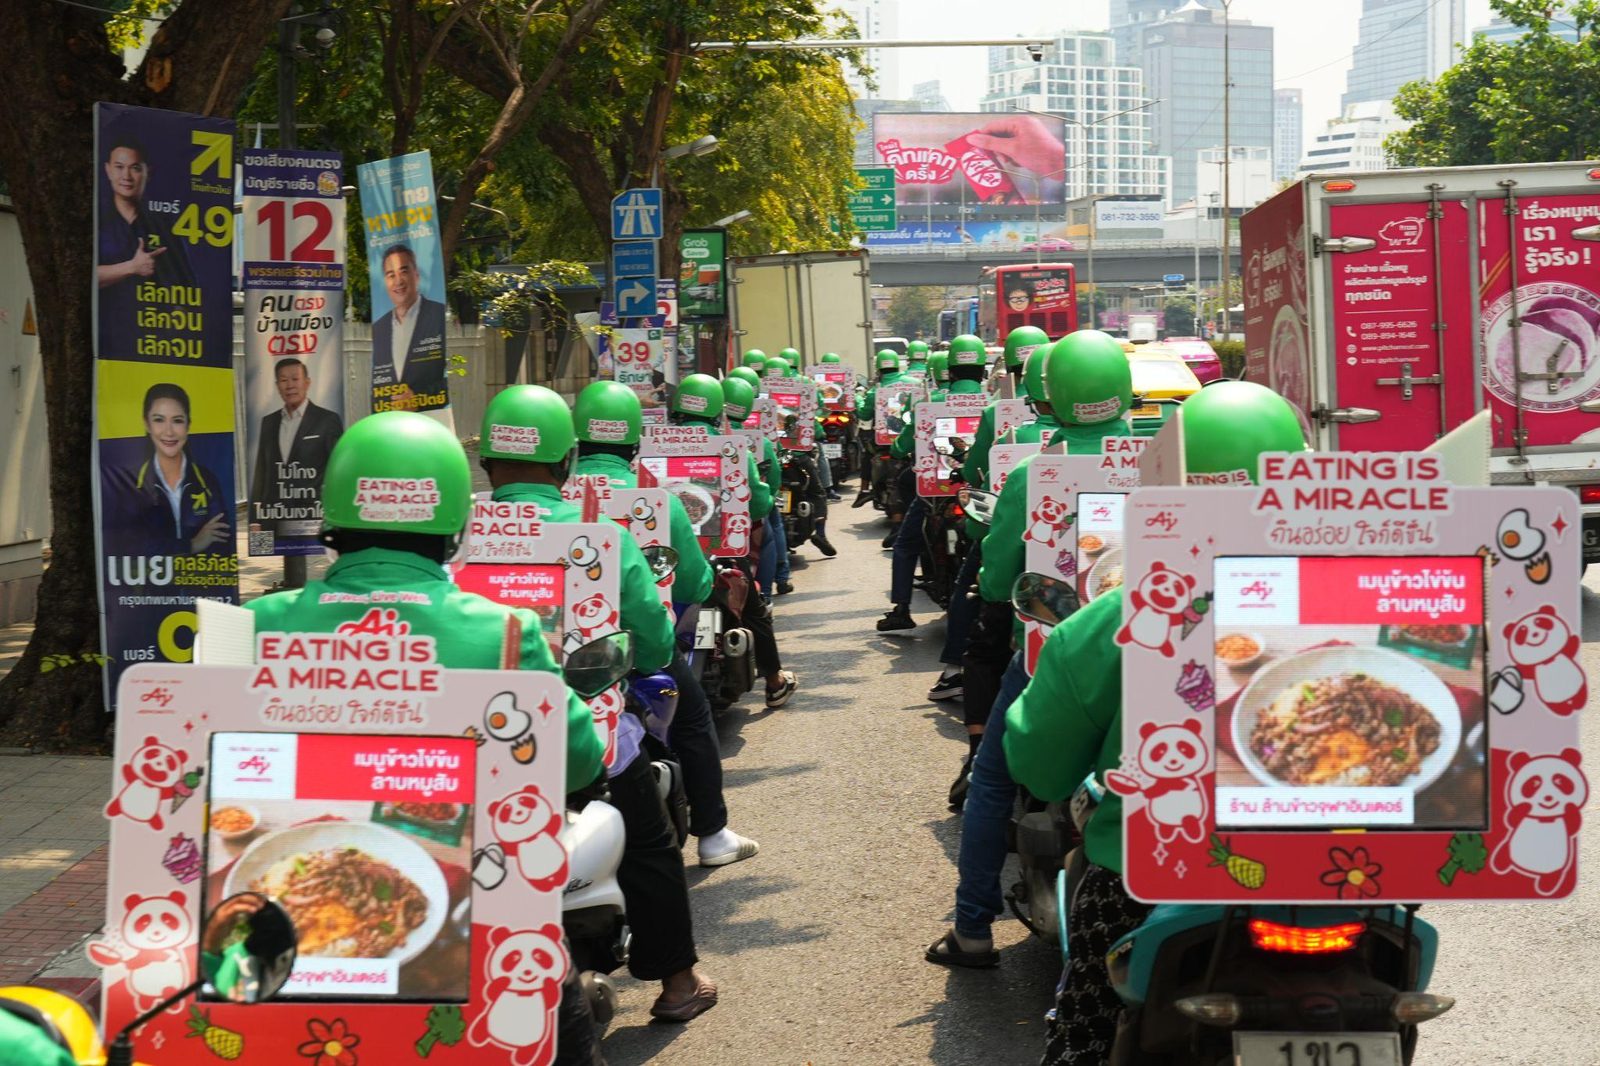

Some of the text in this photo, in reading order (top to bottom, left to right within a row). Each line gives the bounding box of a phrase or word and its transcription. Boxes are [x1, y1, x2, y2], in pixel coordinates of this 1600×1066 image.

[244, 153, 342, 170] ขอเสียงคนตรง
[245, 175, 316, 191] บัญชีรายชื่อ
[392, 185, 429, 207] ไทย
[149, 199, 233, 247] เบอร์ 49
[257, 200, 335, 262] 12
[683, 238, 708, 247] Grab
[1523, 226, 1556, 242] เรา
[1525, 247, 1580, 274] รู้จริง
[136, 281, 202, 307] เลิกทน
[1345, 289, 1392, 304] ทุกชนิด
[136, 307, 202, 332] เลิกจน
[257, 313, 333, 333] บ้านเมือง
[137, 337, 202, 359] เลิกจม
[268, 334, 318, 354] ตรง
[617, 341, 651, 363] 39
[373, 383, 409, 398] พรรค
[654, 427, 693, 435] EATING
[662, 436, 708, 444] MIRACLE
[275, 461, 317, 480] ไม่โกง
[1100, 456, 1115, 469] A
[1265, 458, 1439, 480] EATING IS
[359, 480, 433, 491] EATING IS
[1186, 474, 1229, 485] ATING
[277, 482, 316, 499] ไม่เทา
[356, 493, 438, 504] A MIRACLE
[1257, 487, 1449, 510] A MIRACLE
[253, 500, 324, 520] ไม่เป็นเงาใ
[516, 504, 536, 519] IS
[470, 522, 541, 537] RACLE
[1270, 516, 1434, 546] กินอร่อย ใจก็ดีขึ้น
[107, 555, 173, 586] เนย
[1358, 569, 1466, 596] เมนูข้าวไข่ข้น
[118, 595, 198, 608] กรุงเทพมหานค
[1376, 594, 1466, 619] ลาบหมูสับ
[123, 645, 155, 662] เบอร์
[261, 637, 430, 662] EATING IS
[252, 666, 439, 691] A MIRACLE
[264, 695, 423, 724] กินอร่อย ใจก็ดีขึ้น
[354, 748, 460, 774] เมนูข้าวไข่ข้น
[370, 773, 459, 797] ลาบหมูสับ
